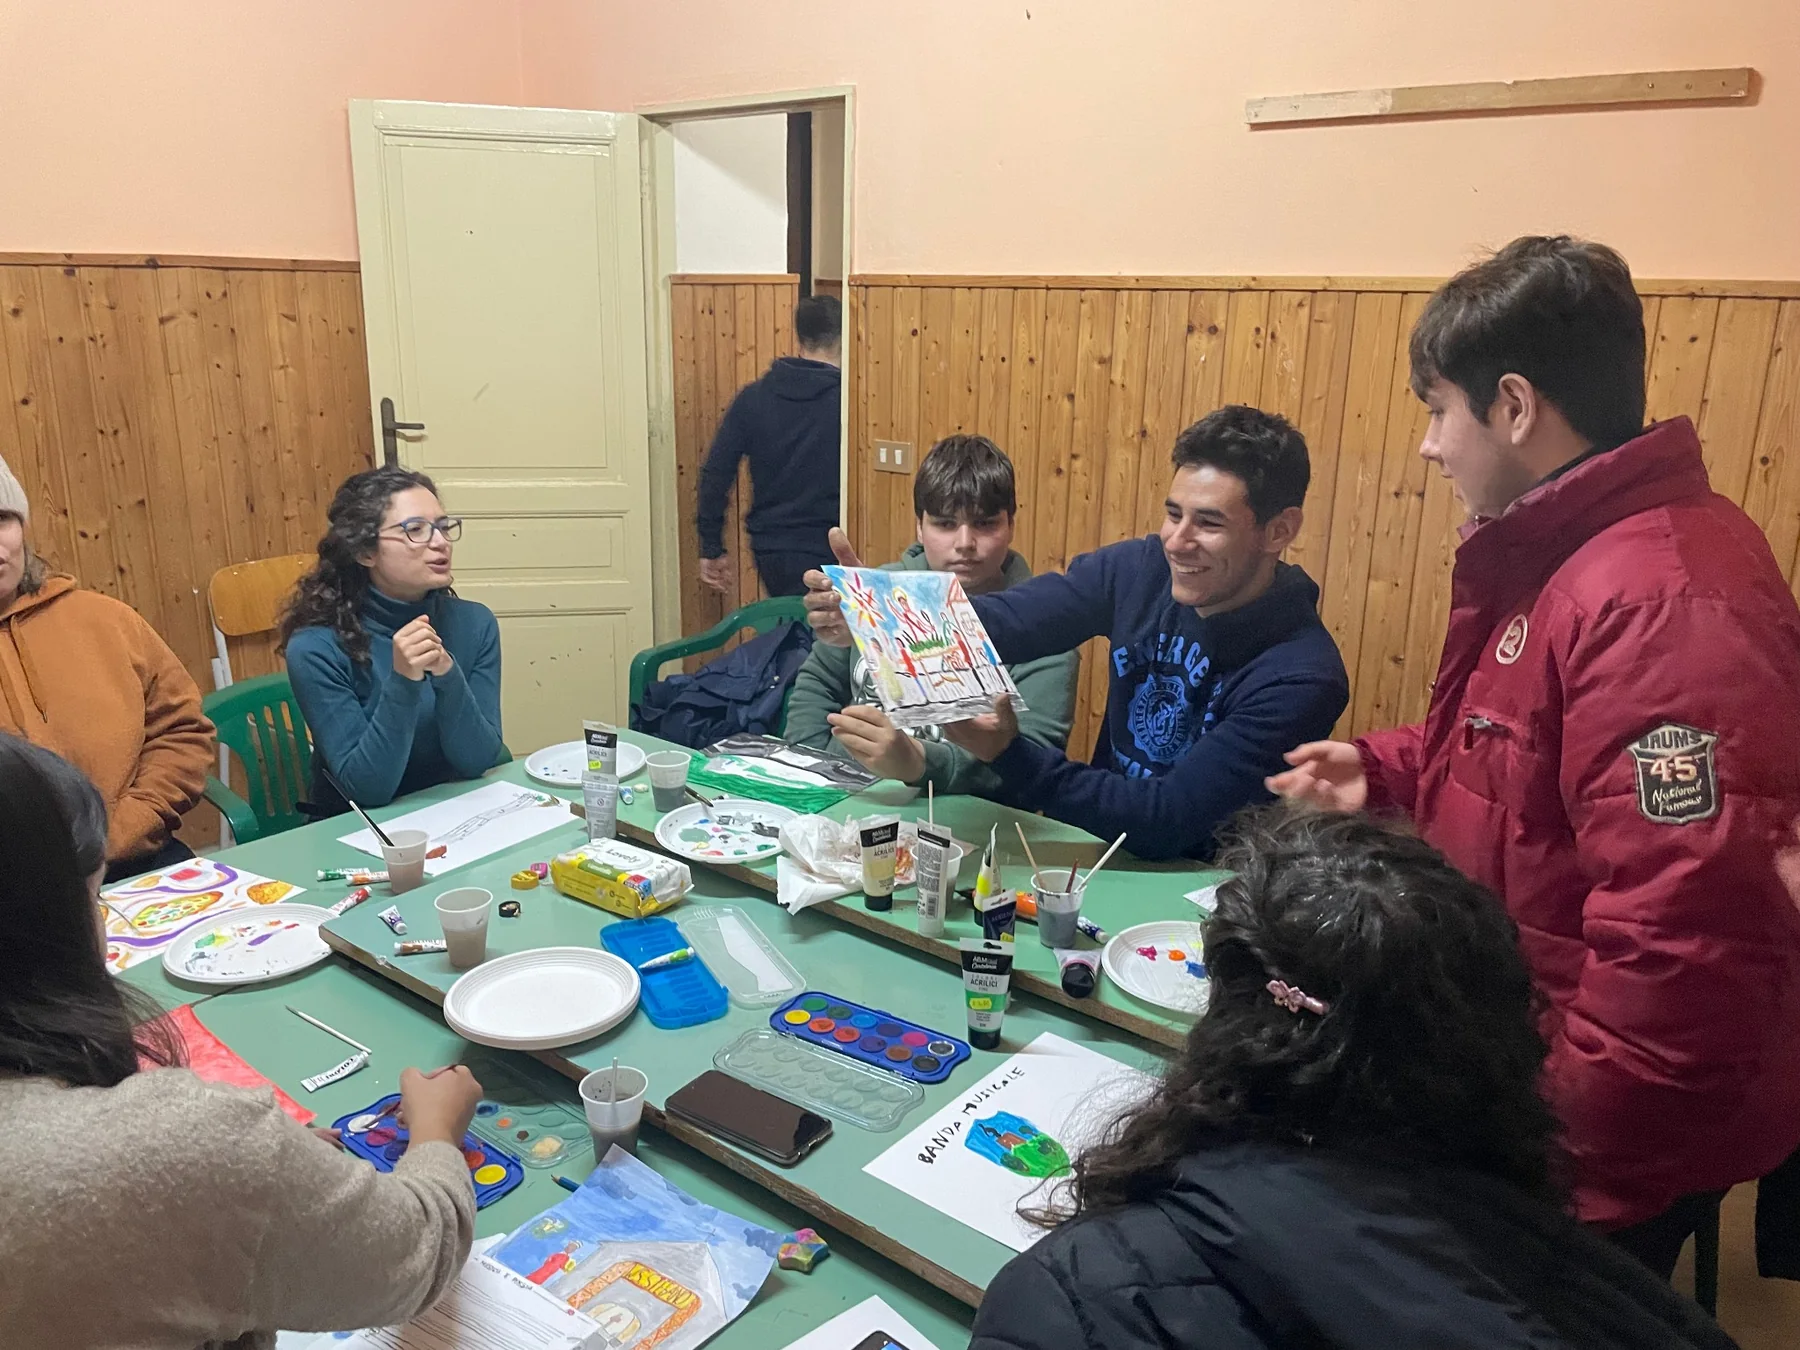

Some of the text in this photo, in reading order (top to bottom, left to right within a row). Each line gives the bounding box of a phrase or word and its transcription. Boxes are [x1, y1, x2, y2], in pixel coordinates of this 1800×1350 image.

[1650, 756, 1697, 782] 45
[970, 979, 998, 988] ACRILICI
[917, 1066, 1026, 1165] BANDA MUSICALE
